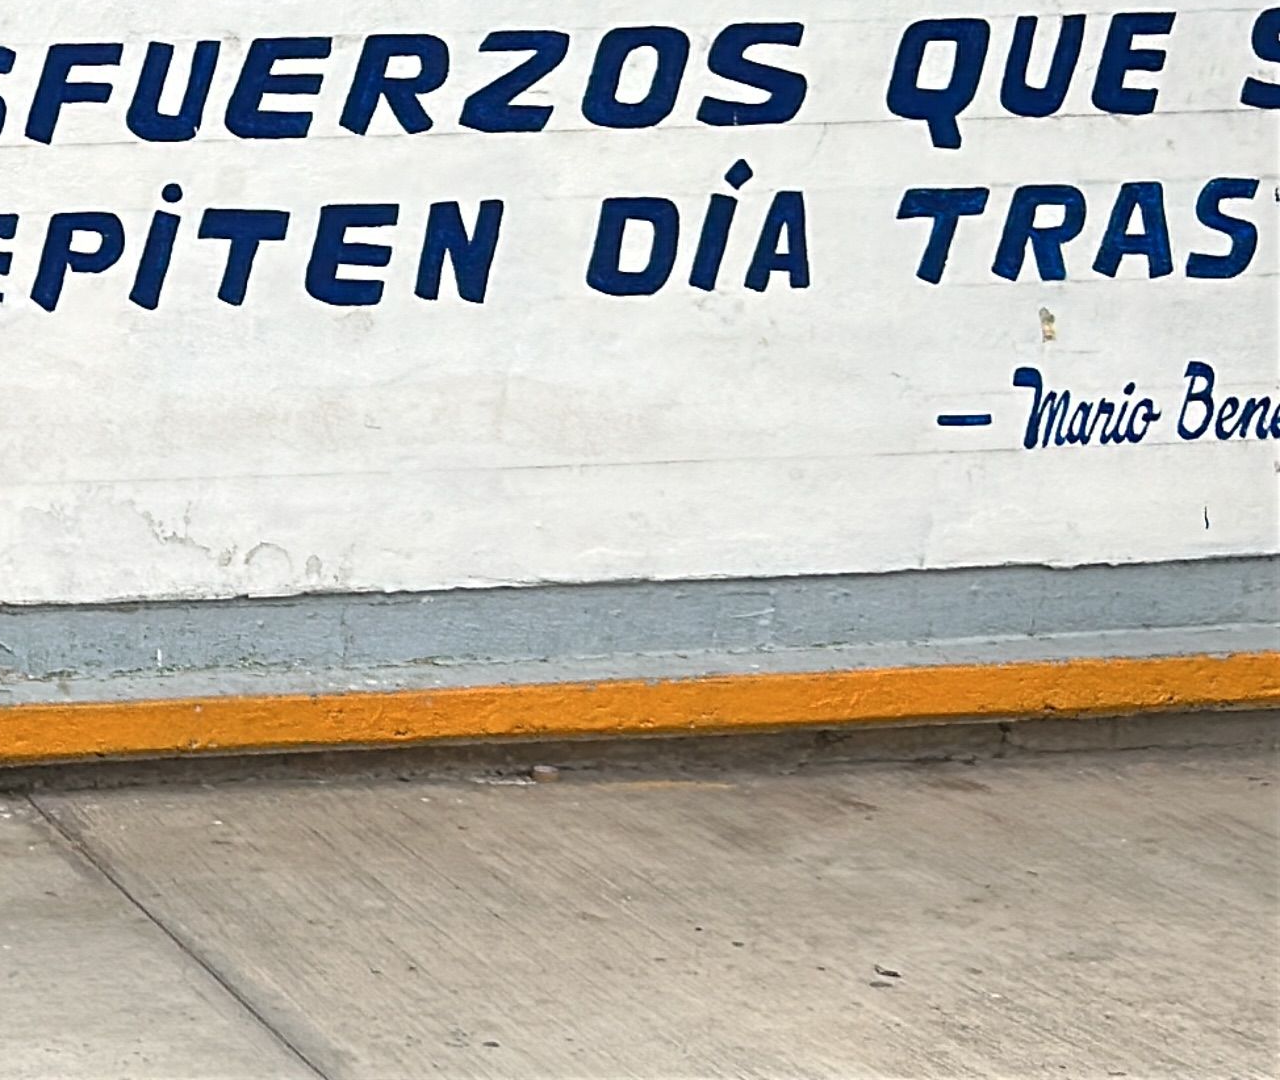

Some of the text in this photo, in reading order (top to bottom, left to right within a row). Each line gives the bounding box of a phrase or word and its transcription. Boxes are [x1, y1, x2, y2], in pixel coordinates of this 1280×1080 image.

[886, 11, 1177, 150] QUE
[585, 159, 810, 296] DÍA
[896, 177, 1260, 285] TRAS
[1012, 366, 1163, 450] Mario
